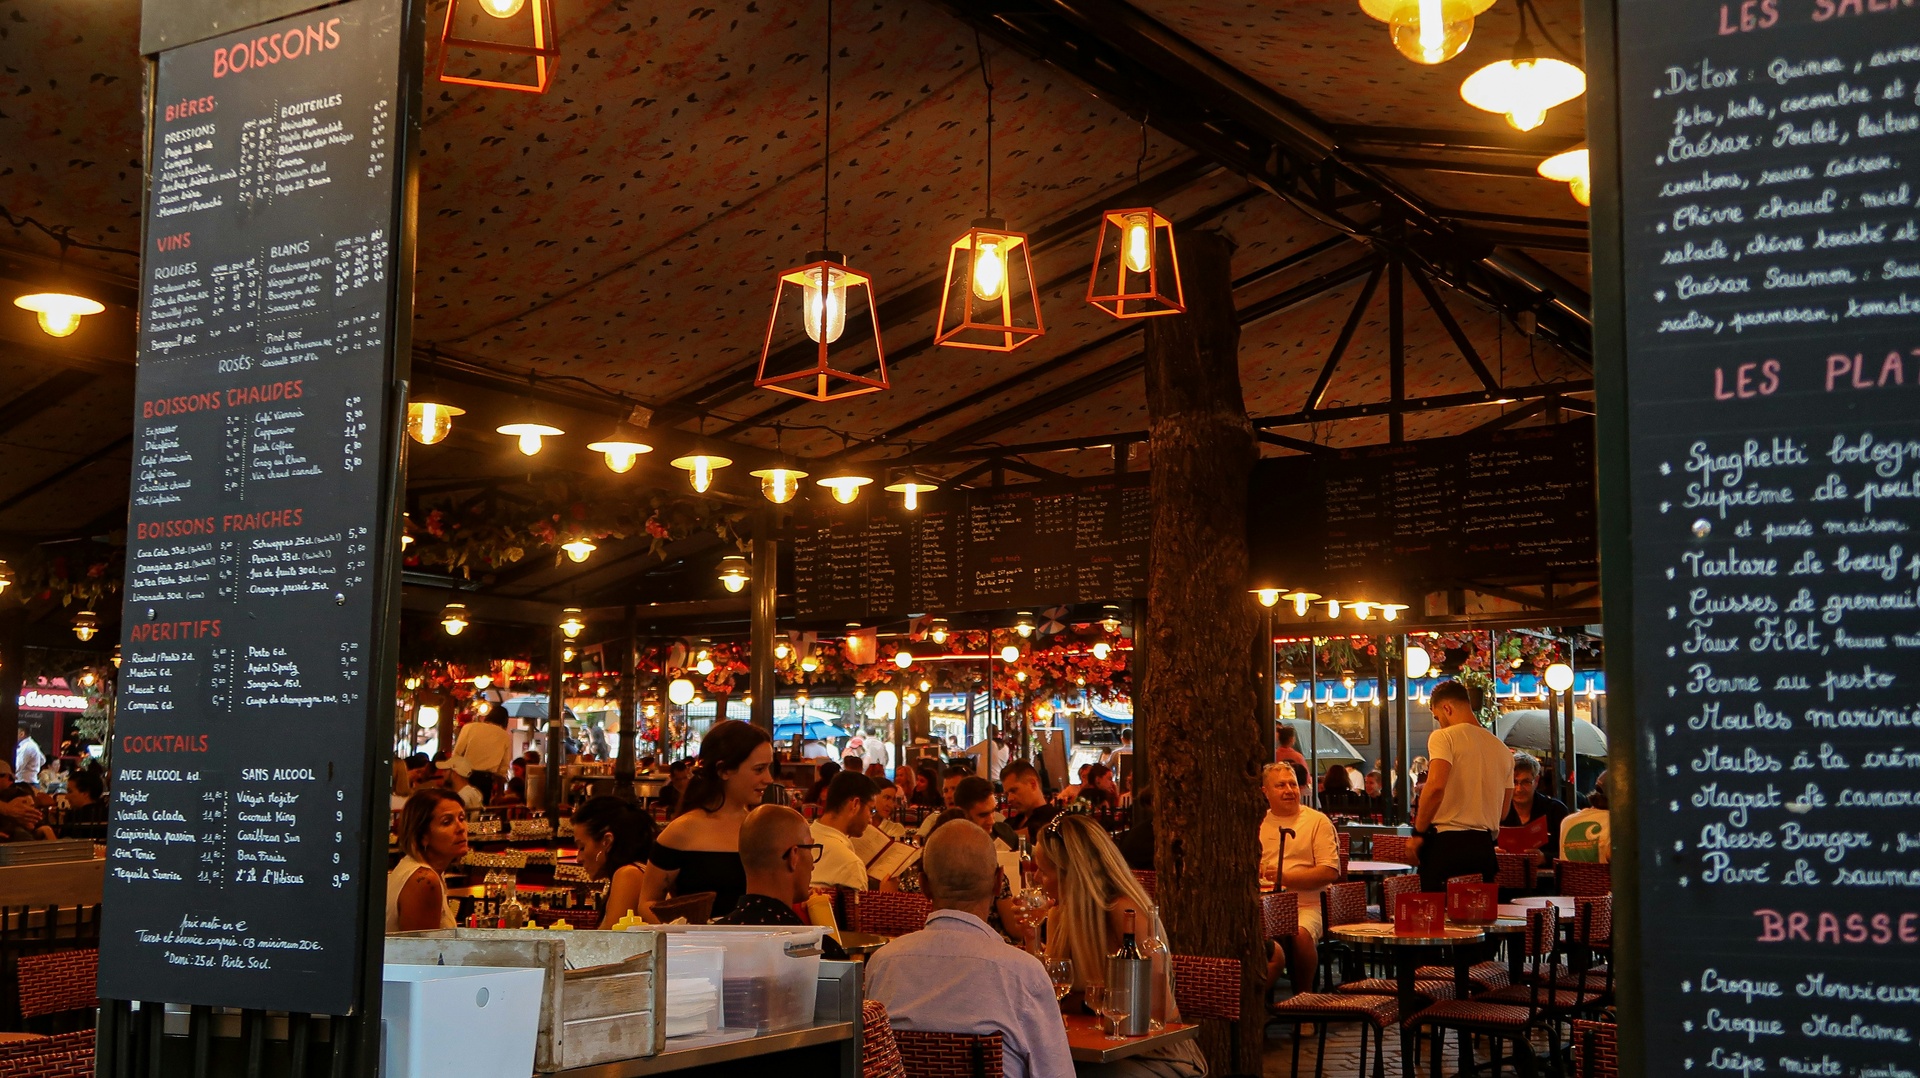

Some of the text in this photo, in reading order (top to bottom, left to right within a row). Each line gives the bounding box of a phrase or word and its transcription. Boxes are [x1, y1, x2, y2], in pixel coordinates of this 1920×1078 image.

[1718, 0, 1779, 36] LES
[213, 18, 341, 78] BOISSONS
[1665, 58, 1738, 95] Détox
[1883, 78, 1905, 100] et
[165, 95, 215, 122] BIÈRES
[281, 93, 343, 118] BOUTEILLES
[164, 123, 216, 144] PRESSIONS
[1756, 165, 1815, 186] sauce
[1673, 182, 1911, 232] Chèvre chaud miel
[1892, 219, 1919, 242] et
[156, 232, 191, 252] VINS
[270, 240, 310, 258] BLANCS
[155, 262, 198, 279] ROUGES
[1763, 265, 1857, 289] Saumon
[1714, 350, 1920, 400] LES PLA
[143, 380, 303, 418] BOISSONS CHAUDES
[271, 440, 295, 455] Coffee
[1684, 437, 1809, 488] Spaghetti
[1810, 473, 1849, 502] de
[137, 509, 304, 540] BOISSONS FRAICHES
[1734, 519, 1752, 538] et
[1761, 518, 1814, 544] purée
[137, 548, 170, 558] Coca Cola
[251, 554, 280, 564] Perrier
[1681, 547, 1779, 578] Tartare
[1788, 550, 1825, 576] de
[137, 562, 173, 574] Orangina
[132, 592, 166, 602] Limonade
[249, 580, 311, 597] Orange pressée
[1689, 587, 1779, 616] Cuisses
[1784, 587, 1816, 613] de
[130, 620, 222, 643] APERITIFS
[1682, 618, 1740, 654] Faux
[248, 646, 270, 657] Porto
[129, 668, 157, 677] Martini
[248, 663, 270, 676] Apérol
[128, 684, 155, 694] Muscat
[247, 679, 282, 692] Sangria
[1686, 662, 1896, 702] Penne au pesto
[127, 701, 159, 714] Campari
[246, 694, 322, 708] Coupe de champagne
[1688, 702, 1792, 731] Moules
[123, 734, 208, 754] COCKTAILS
[1691, 745, 1782, 773] Moules
[1817, 742, 1850, 770] la
[120, 769, 183, 781] AVEC ALCOOL
[242, 768, 316, 781] SANS ALCOOL
[120, 788, 150, 806] Mojito
[237, 790, 265, 807] Virgin
[336, 790, 344, 801] 9
[1691, 781, 1782, 828] Magret
[1796, 781, 1827, 808] de
[117, 809, 187, 822] Vanilla Colada
[238, 810, 343, 827] Coconut King 9
[164, 830, 196, 846] passion
[284, 832, 301, 843] Sun
[1696, 822, 1777, 850] Cheese
[115, 848, 157, 860] Gin Tonic
[237, 849, 257, 861] Bora
[114, 866, 182, 884] Tequila Sunrise
[1702, 851, 1771, 883] Pavé
[1780, 858, 1821, 886] de
[222, 921, 234, 931] en
[1753, 908, 1920, 945] BRASSE
[135, 929, 162, 943] Taxes
[163, 931, 173, 943] et
[174, 934, 206, 946] service
[257, 938, 300, 950] minimum
[221, 954, 246, 968] Pinte
[1700, 968, 1920, 1004] Croque Monsieur
[1702, 1007, 1912, 1044] Croque Madame
[1705, 1047, 1767, 1078] Crêpe
[1778, 1054, 1843, 1076] mixte
